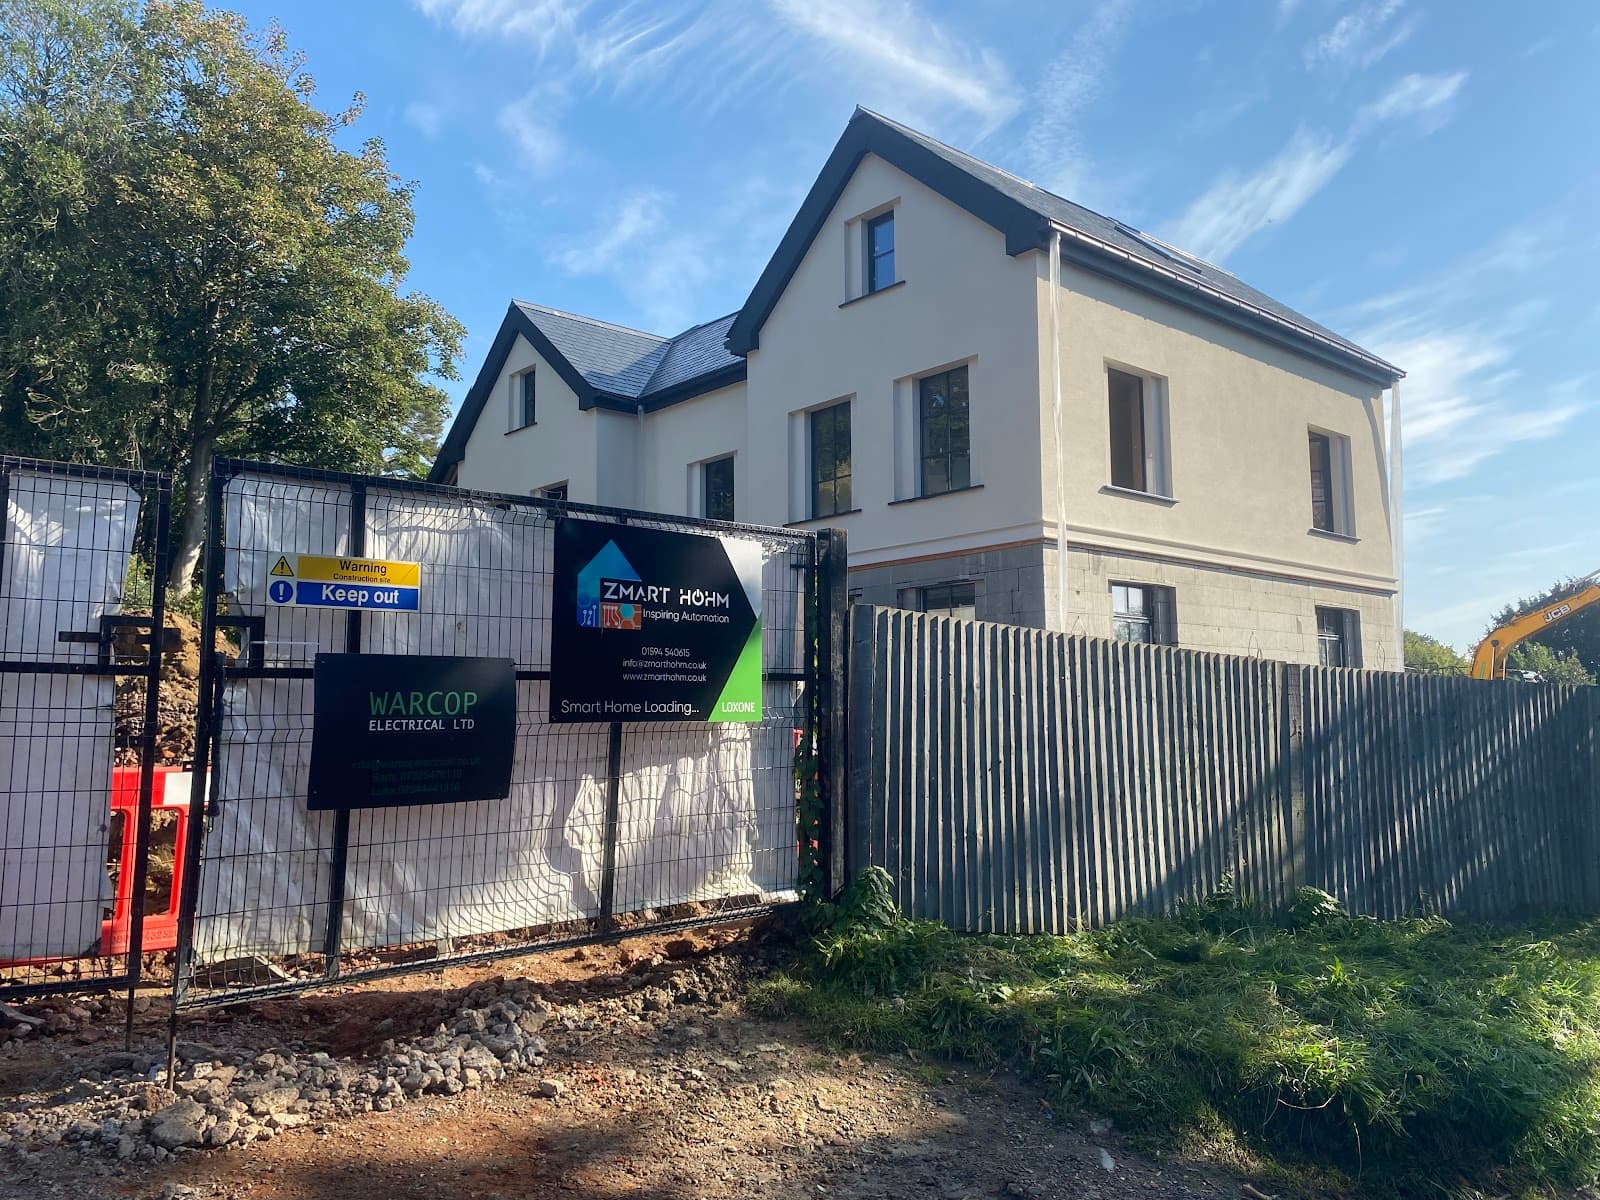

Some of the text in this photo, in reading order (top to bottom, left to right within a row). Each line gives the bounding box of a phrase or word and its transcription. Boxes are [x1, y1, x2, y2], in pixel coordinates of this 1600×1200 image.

[339, 560, 387, 577] Warning
[333, 573, 391, 584] Construction site
[321, 584, 400, 606] Keep out
[603, 582, 671, 604] ZMART
[642, 608, 730, 624] Inspiring Automation
[1544, 604, 1571, 623] JCB
[641, 647, 690, 658] 01594 540615
[622, 658, 707, 670] info@zmarthohm.co.uk
[622, 672, 707, 682] www.zmarthohm.co.uk
[369, 691, 478, 716] WARCOP
[560, 699, 601, 713] Smart
[604, 701, 642, 713] Home
[721, 702, 756, 713] LOXONE
[368, 718, 475, 731] ELECTRICAL LTD
